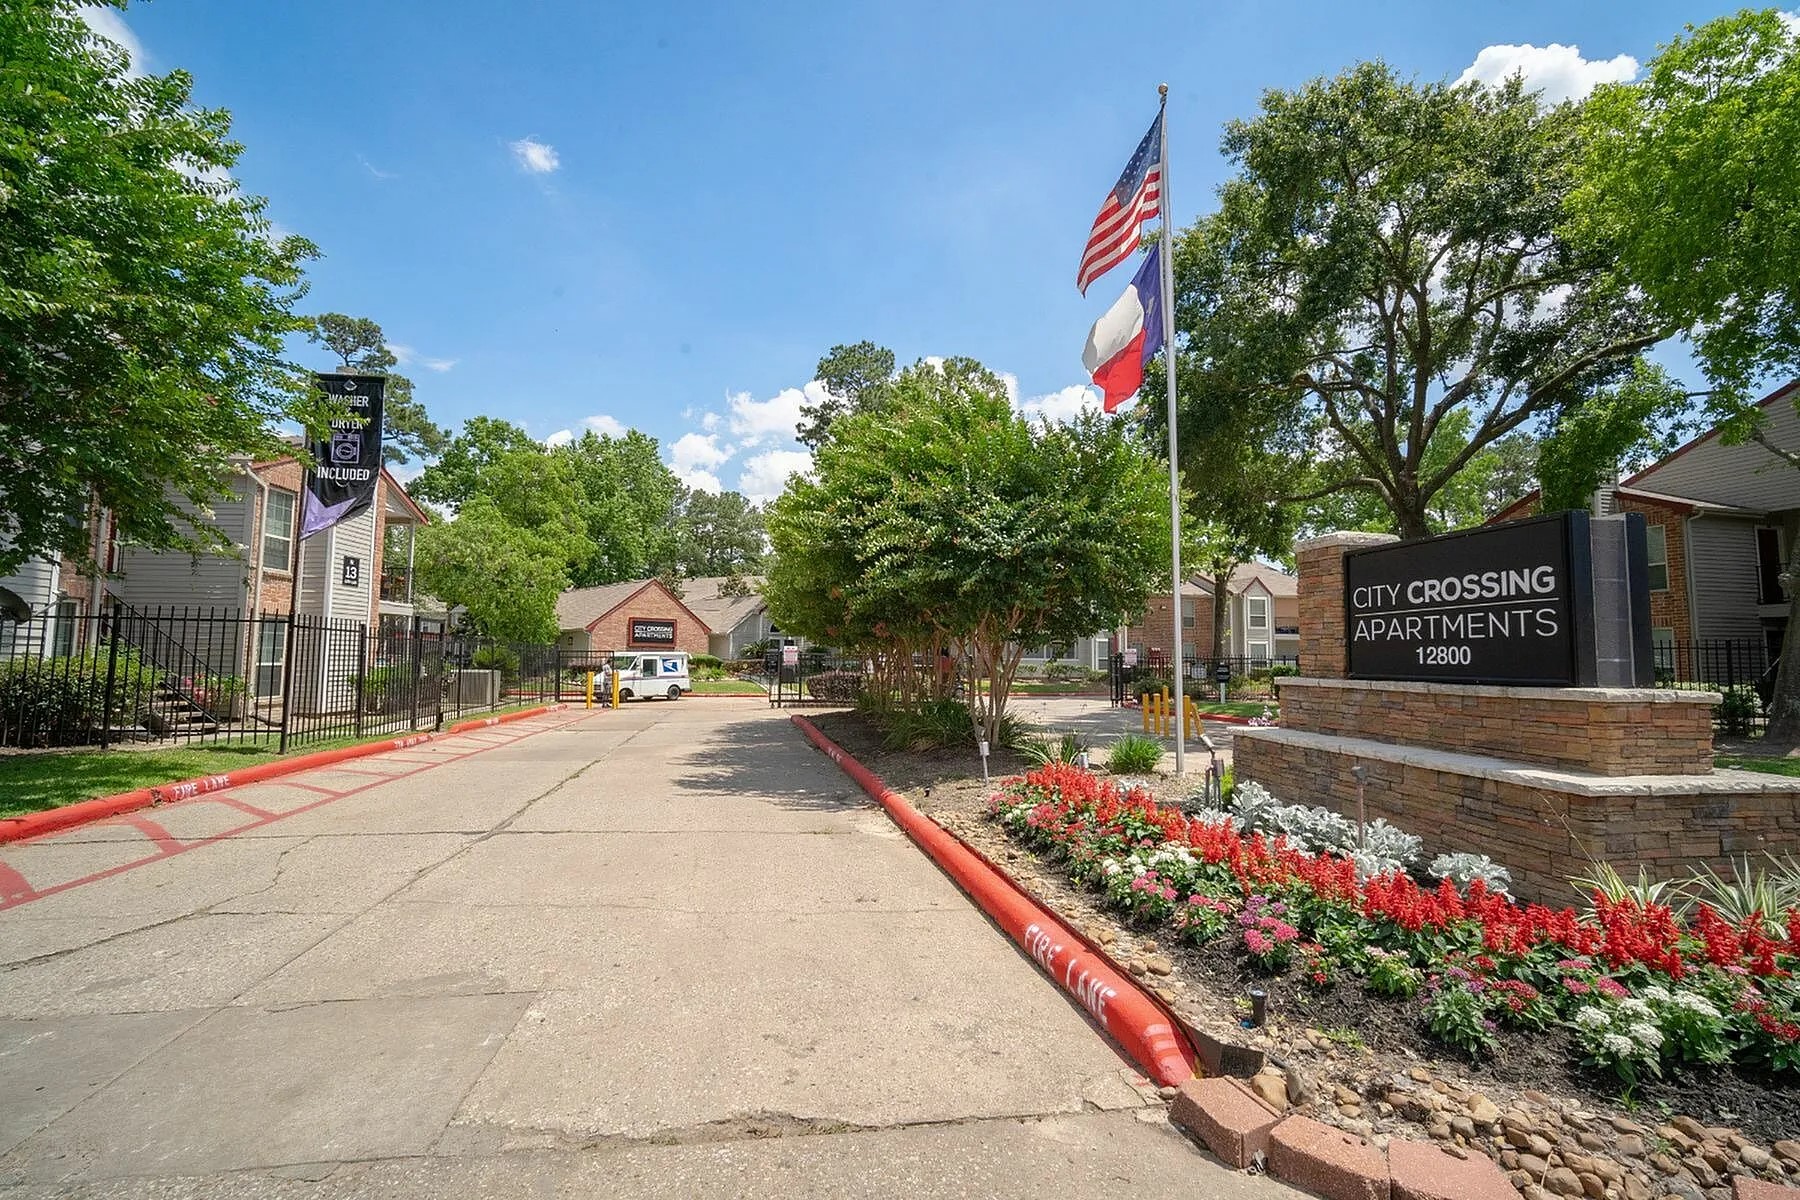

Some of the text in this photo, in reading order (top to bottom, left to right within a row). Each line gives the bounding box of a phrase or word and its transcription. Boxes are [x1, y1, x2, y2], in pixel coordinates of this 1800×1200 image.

[317, 466, 370, 481] INCLUDED
[345, 566, 357, 579] 13
[1353, 565, 1556, 609] CITY CROSSING
[1354, 608, 1559, 641] APARTMENTS
[1416, 645, 1471, 665] 12800
[172, 782, 198, 799] FIRE
[1024, 924, 1117, 1025] FIRE LANE
